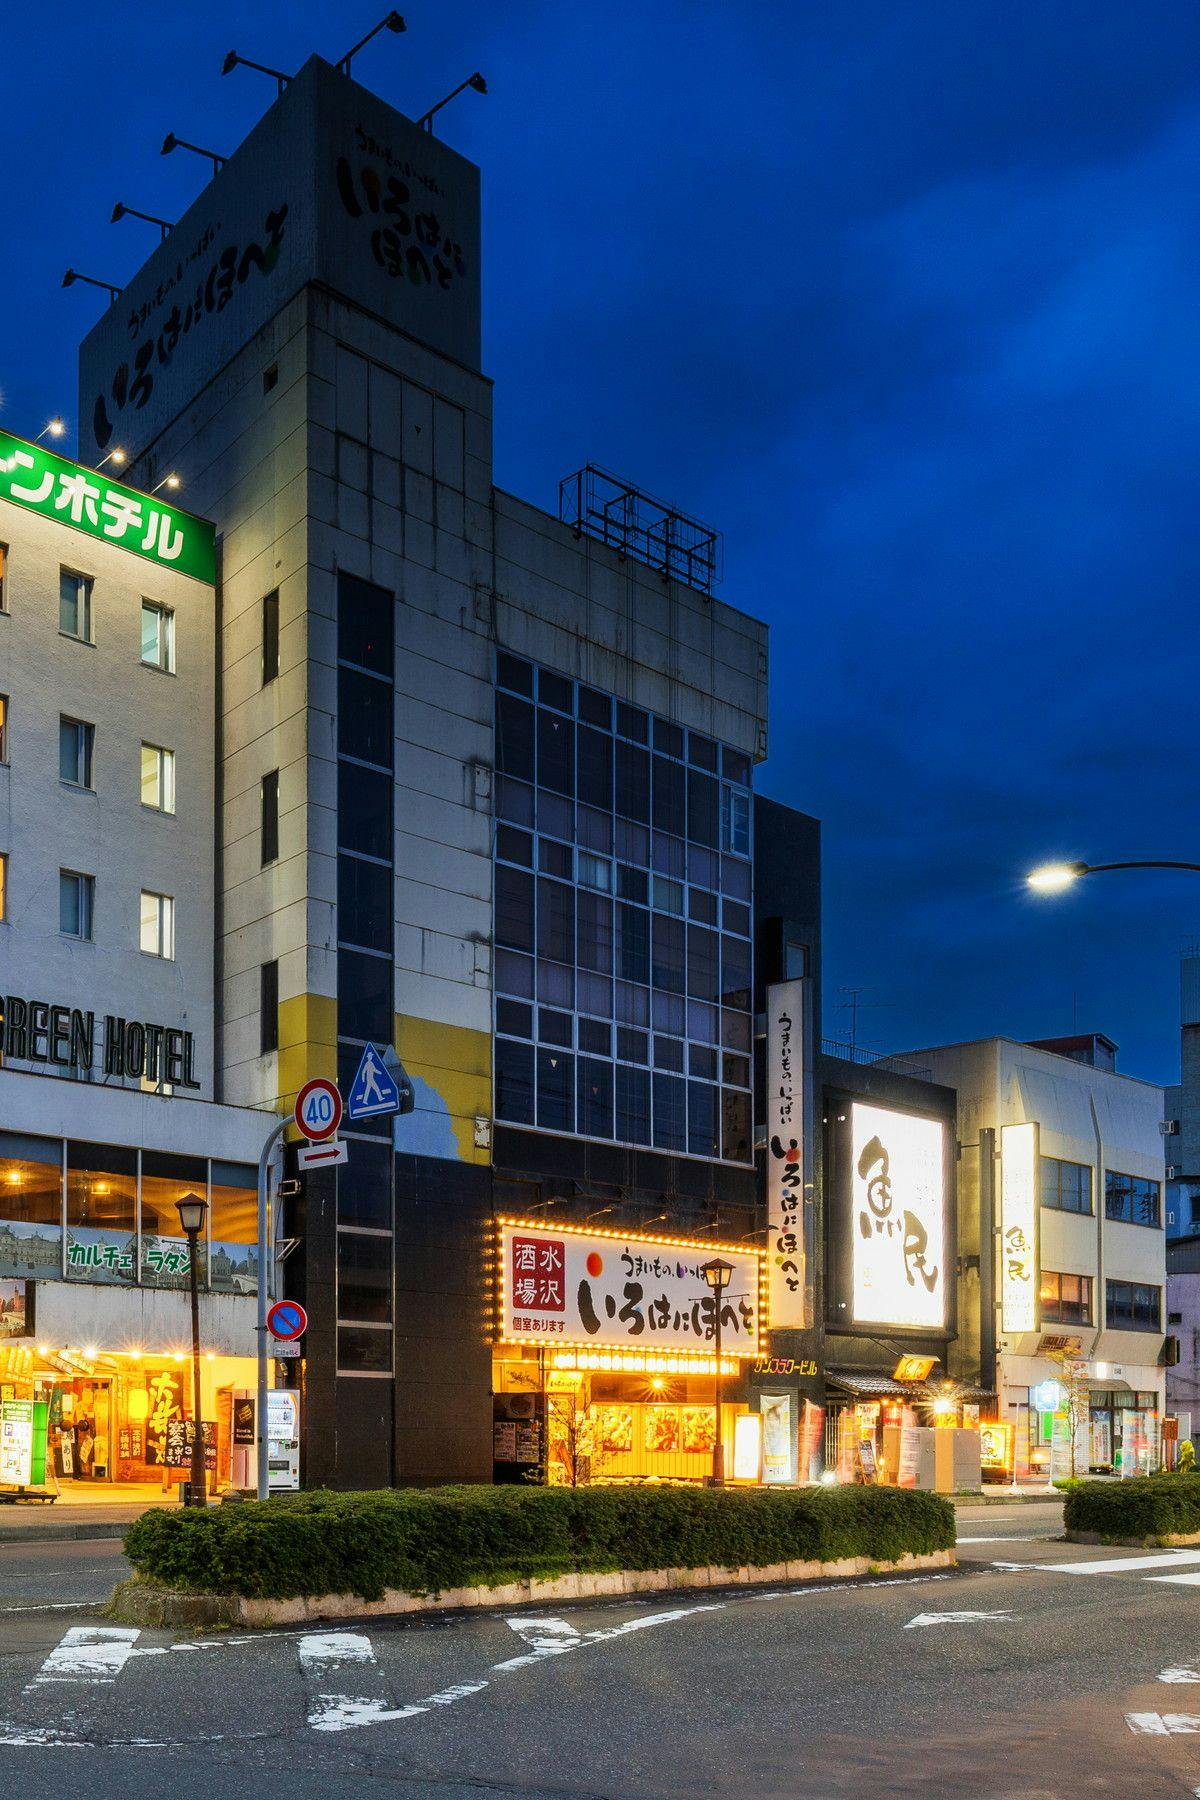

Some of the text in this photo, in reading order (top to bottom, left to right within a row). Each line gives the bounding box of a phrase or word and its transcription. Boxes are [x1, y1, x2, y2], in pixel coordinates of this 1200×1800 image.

[103, 1015, 201, 1090] HOTEL
[307, 1095, 331, 1123] 40
[771, 1135, 801, 1292] いろはにほへと
[858, 1135, 938, 1293] 魚民
[68, 1243, 133, 1269] カルチェ
[512, 1316, 566, 1333] 個室あります
[577, 1279, 754, 1341] いろはにほへと
